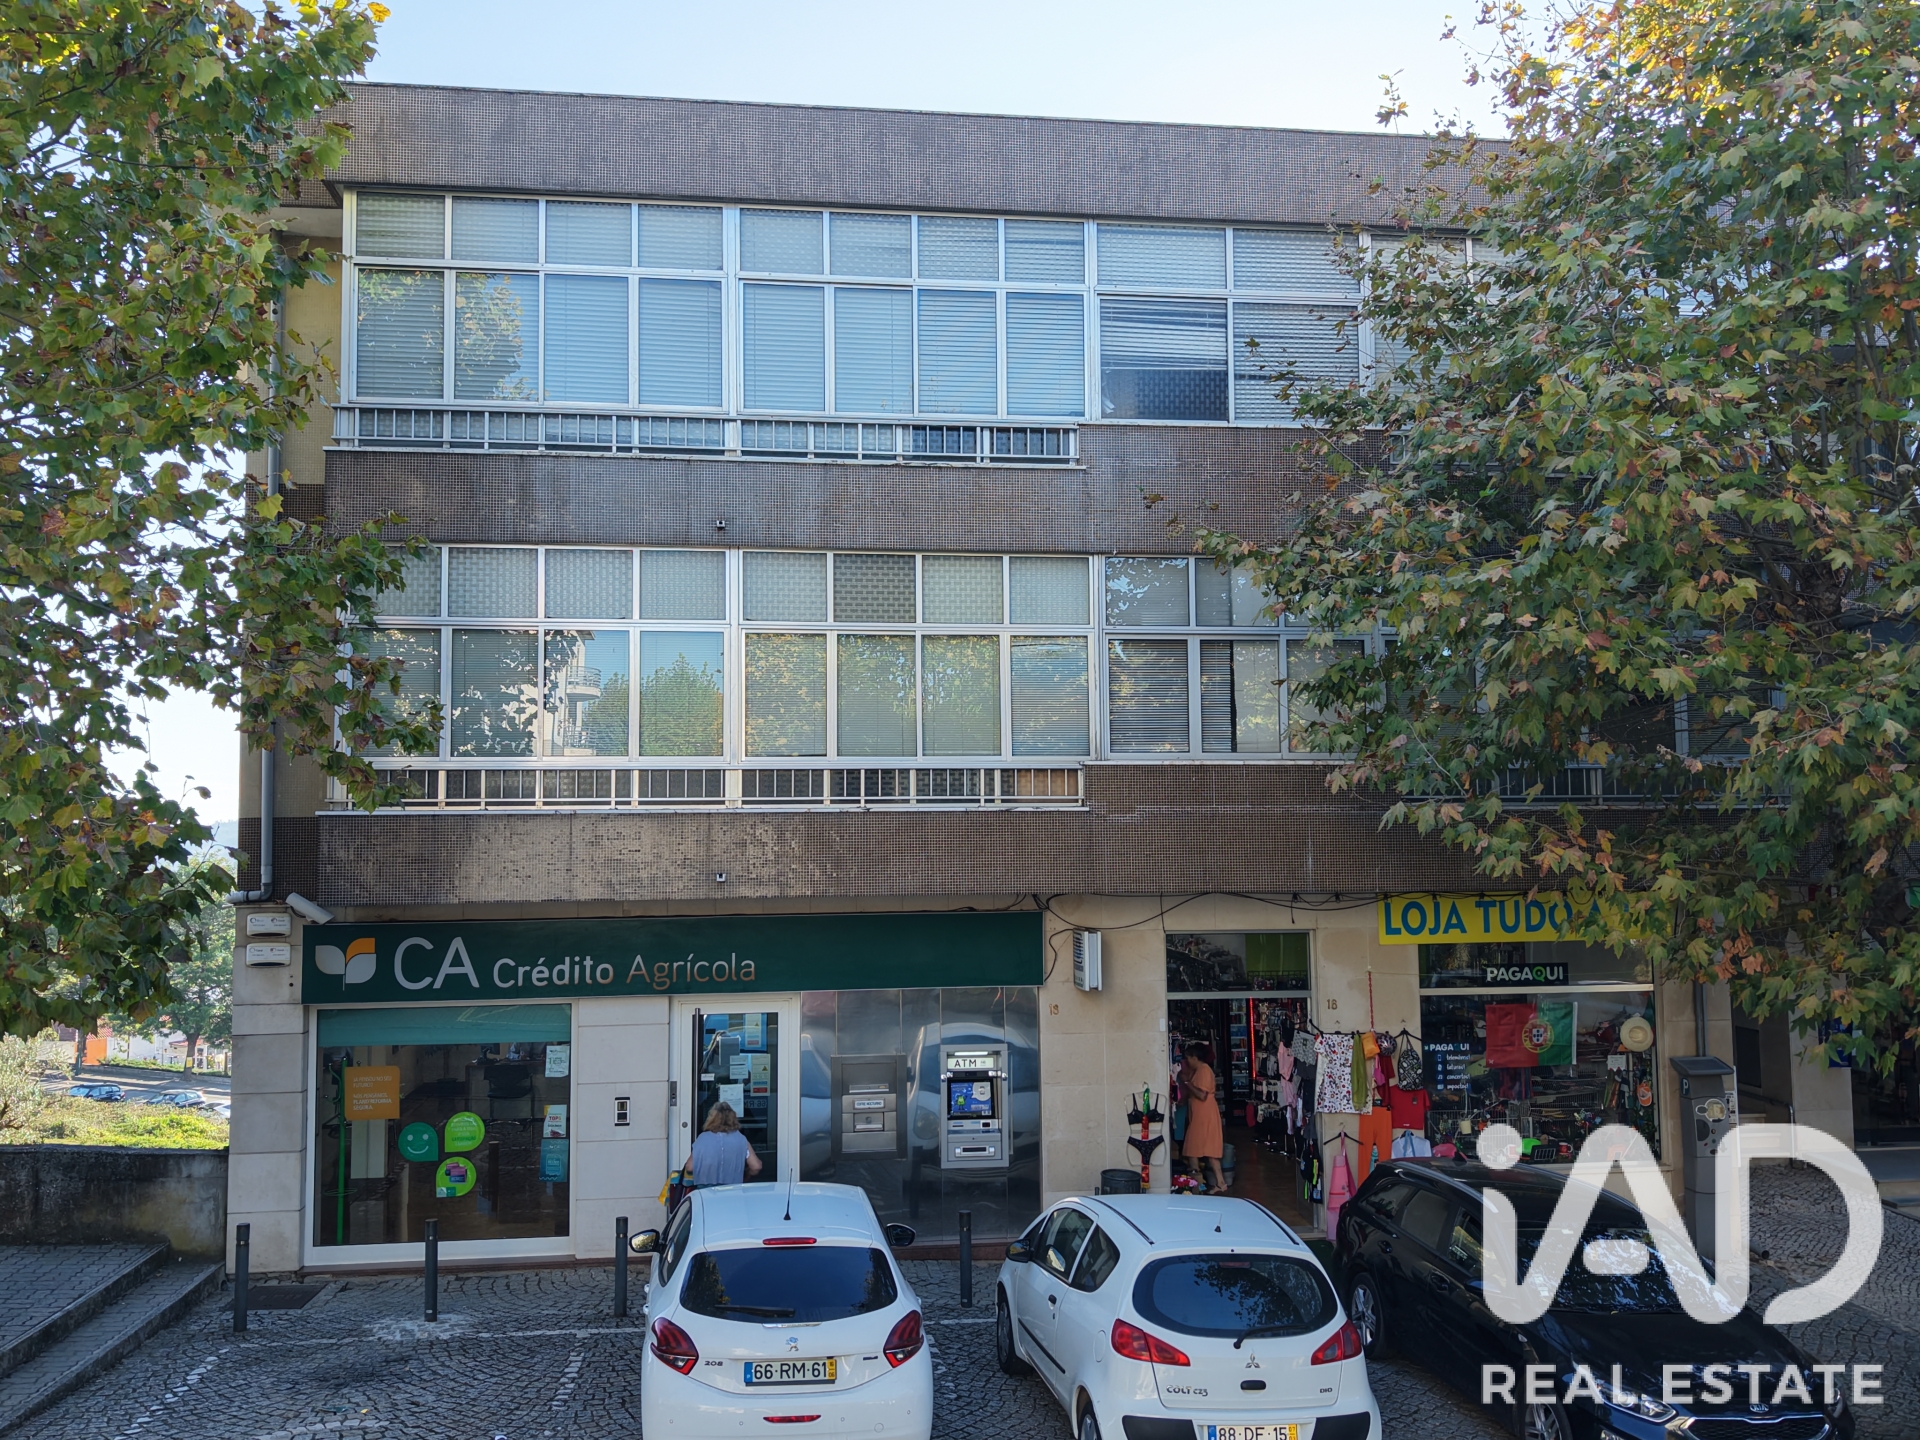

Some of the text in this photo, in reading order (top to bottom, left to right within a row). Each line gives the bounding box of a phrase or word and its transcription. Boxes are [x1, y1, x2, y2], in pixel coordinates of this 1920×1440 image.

[1384, 899, 1467, 936] LOJA
[1475, 897, 1573, 934] TUDO
[393, 937, 756, 991] CA Crédito Agrícola
[1485, 965, 1563, 984] PAGAQUI
[954, 1059, 977, 1069] ATM
[1682, 1078, 1690, 1096] P
[704, 1360, 723, 1368] 208
[1166, 1385, 1192, 1394] COLT
